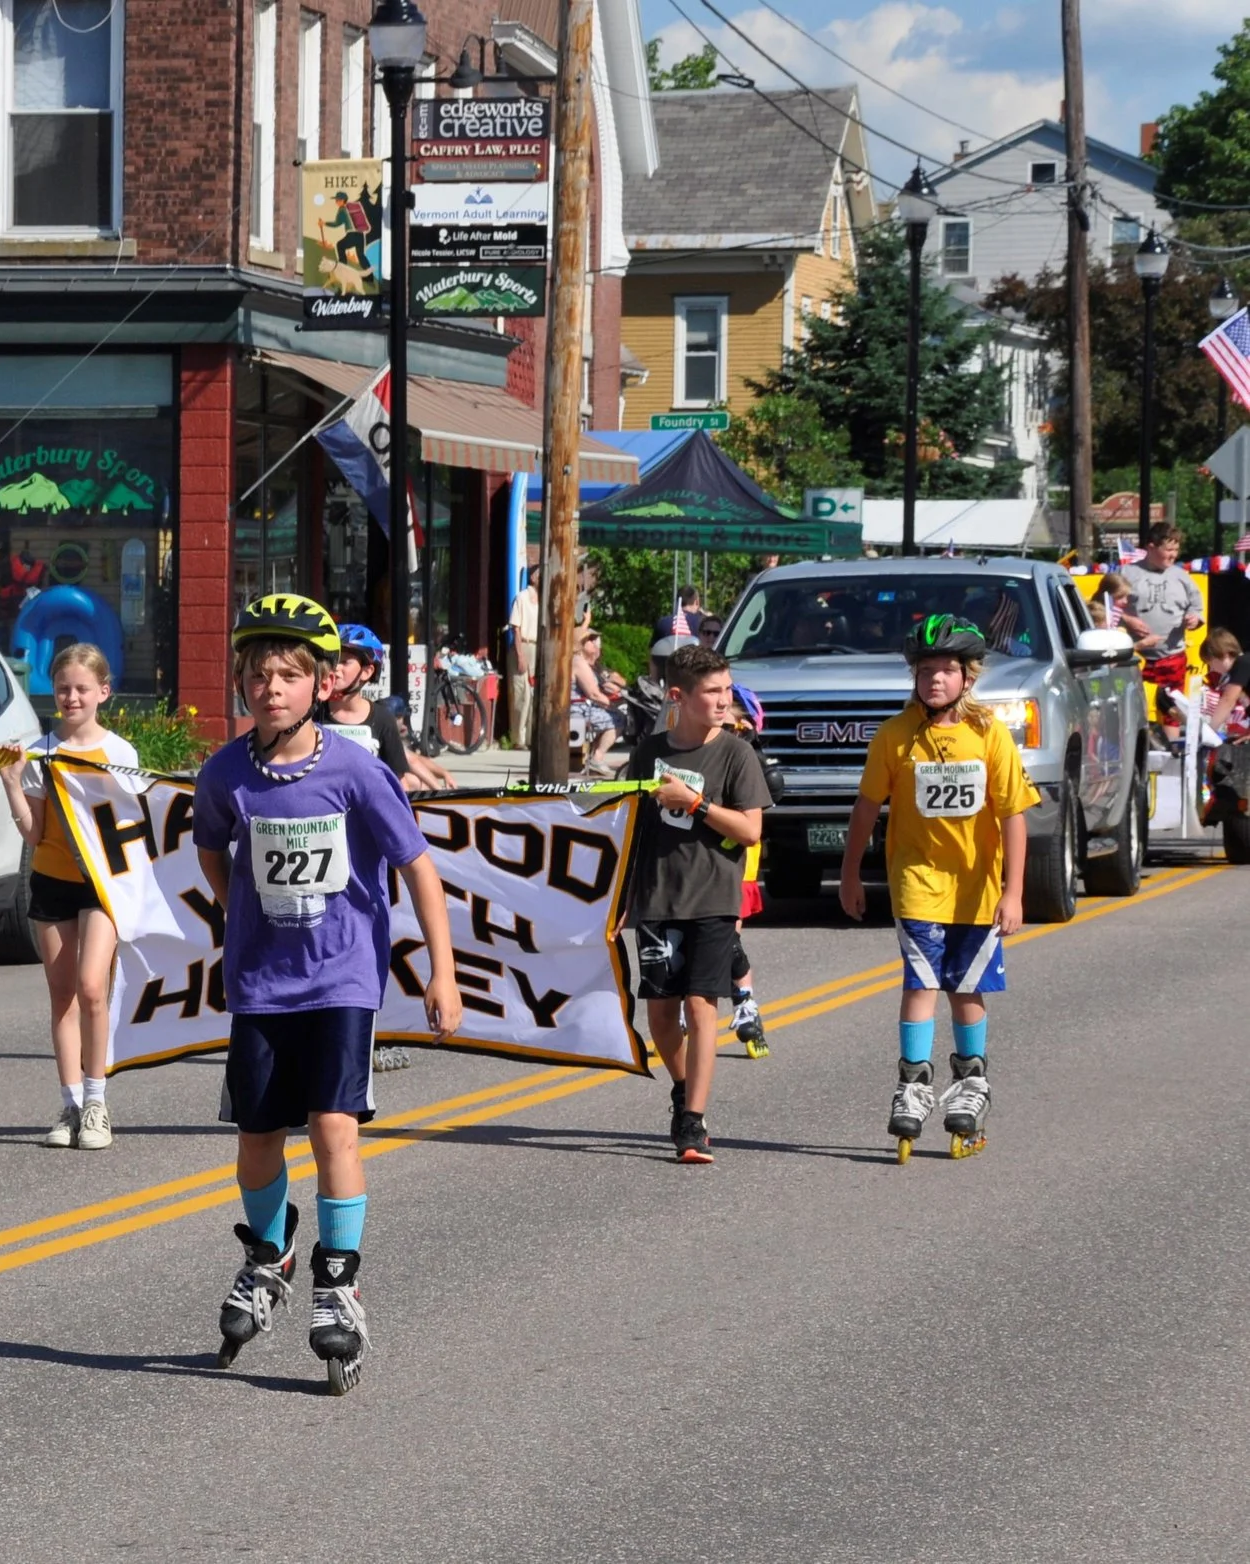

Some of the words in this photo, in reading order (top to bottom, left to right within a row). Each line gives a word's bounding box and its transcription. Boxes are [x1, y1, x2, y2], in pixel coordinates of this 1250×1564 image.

[440, 99, 543, 121] edgeworks
[440, 117, 543, 137] creative
[420, 143, 470, 156] CAFFRY
[474, 143, 506, 156] LAW,
[510, 144, 540, 155] PLLC
[324, 176, 358, 188] HIKE
[413, 210, 459, 220] Vermont
[462, 210, 492, 220] Adult
[496, 210, 545, 222] Learning
[452, 231, 469, 240] Life
[470, 231, 492, 240] After
[493, 231, 518, 240] Mold
[411, 249, 431, 257] Nicole
[416, 271, 493, 303] Waterbury
[494, 272, 538, 305] Sports
[312, 296, 373, 318] Waterbury
[659, 416, 704, 429] Foundry
[616, 524, 699, 546] Sports
[740, 528, 811, 547] More
[362, 690, 383, 699] BIKE
[796, 721, 882, 742] GMC
[920, 765, 942, 775] GREEN
[944, 764, 980, 774] MOUNTAIN
[942, 774, 958, 783] MILE
[534, 782, 595, 794] ALPHA
[926, 784, 975, 809] 225
[256, 822, 286, 836] GREEN
[288, 819, 338, 835] MOUNTAIN
[93, 791, 618, 904] HAOOD
[286, 837, 308, 849] MILE
[265, 848, 333, 885] 227
